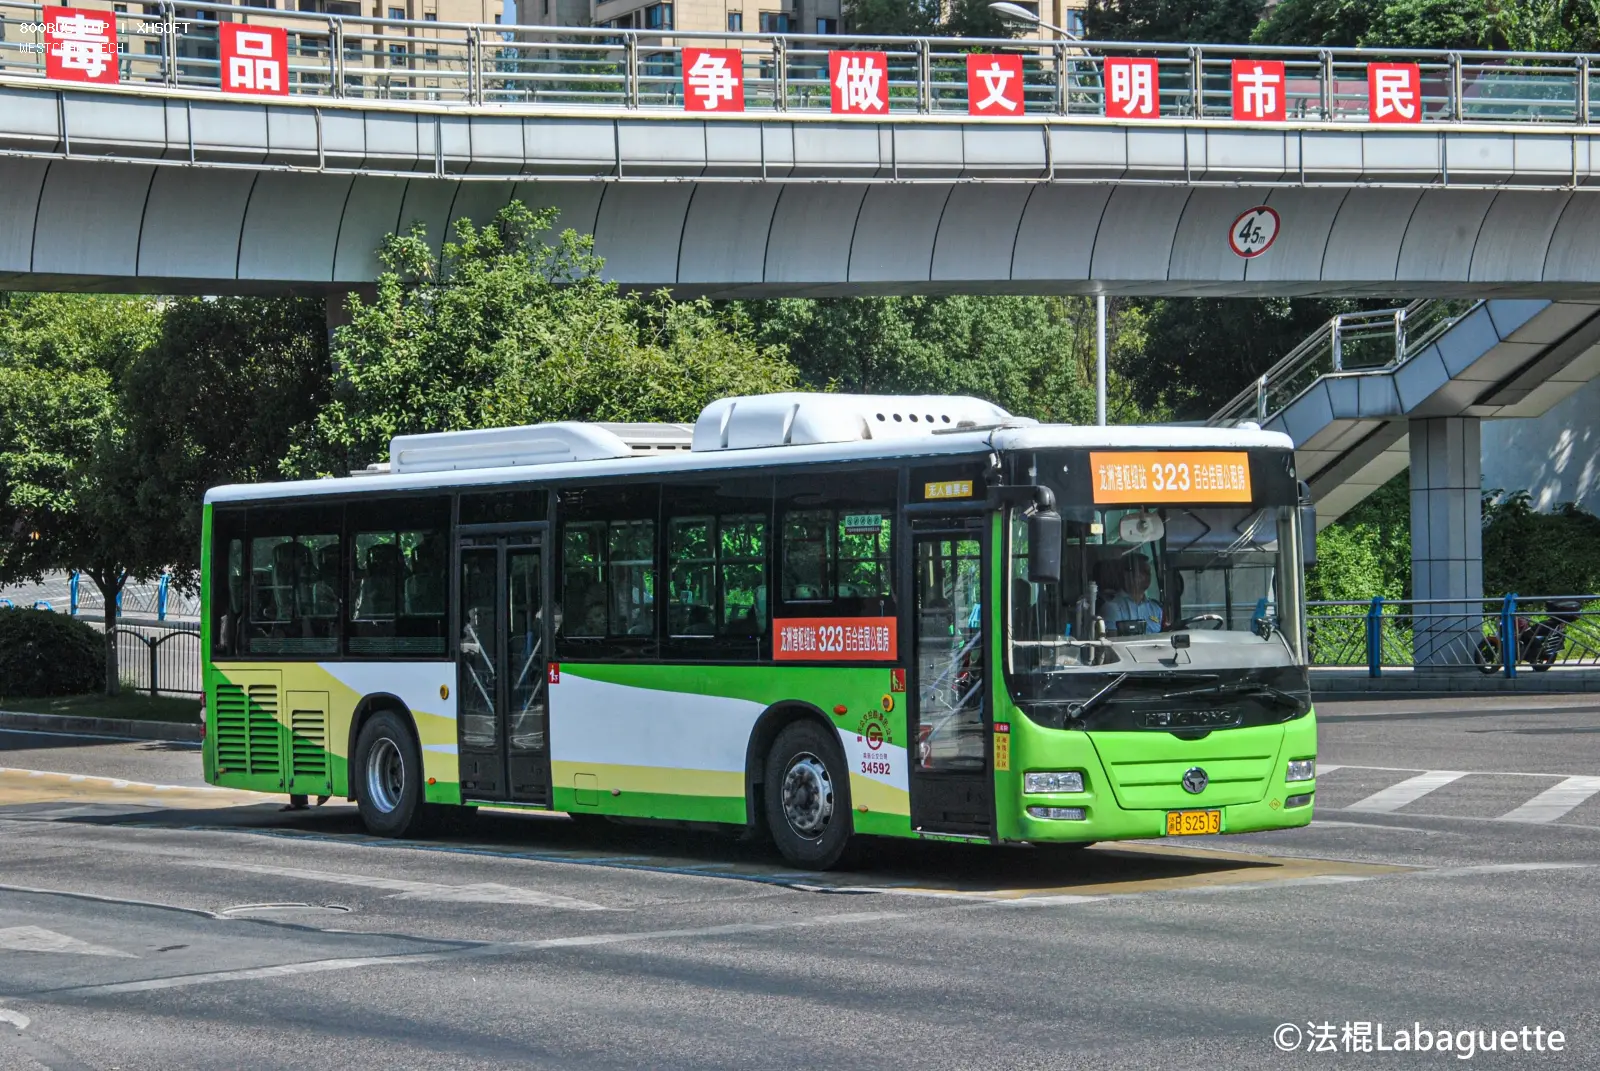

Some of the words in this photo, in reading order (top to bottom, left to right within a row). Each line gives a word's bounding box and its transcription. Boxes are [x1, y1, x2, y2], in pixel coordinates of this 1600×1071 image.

[52, 13, 113, 78] 毒
[229, 30, 281, 91] 品
[688, 52, 739, 110] 争
[835, 56, 883, 112] 做
[975, 62, 1018, 112] 文
[1111, 64, 1153, 115] 明
[1237, 66, 1280, 118] 市
[1375, 69, 1416, 119] 民
[1151, 462, 1191, 491] 323
[1193, 463, 1245, 491] 百合佳园公租房
[818, 625, 844, 653] 323
[845, 626, 889, 652] 百合佳园公租房
[861, 761, 891, 775] 34592
